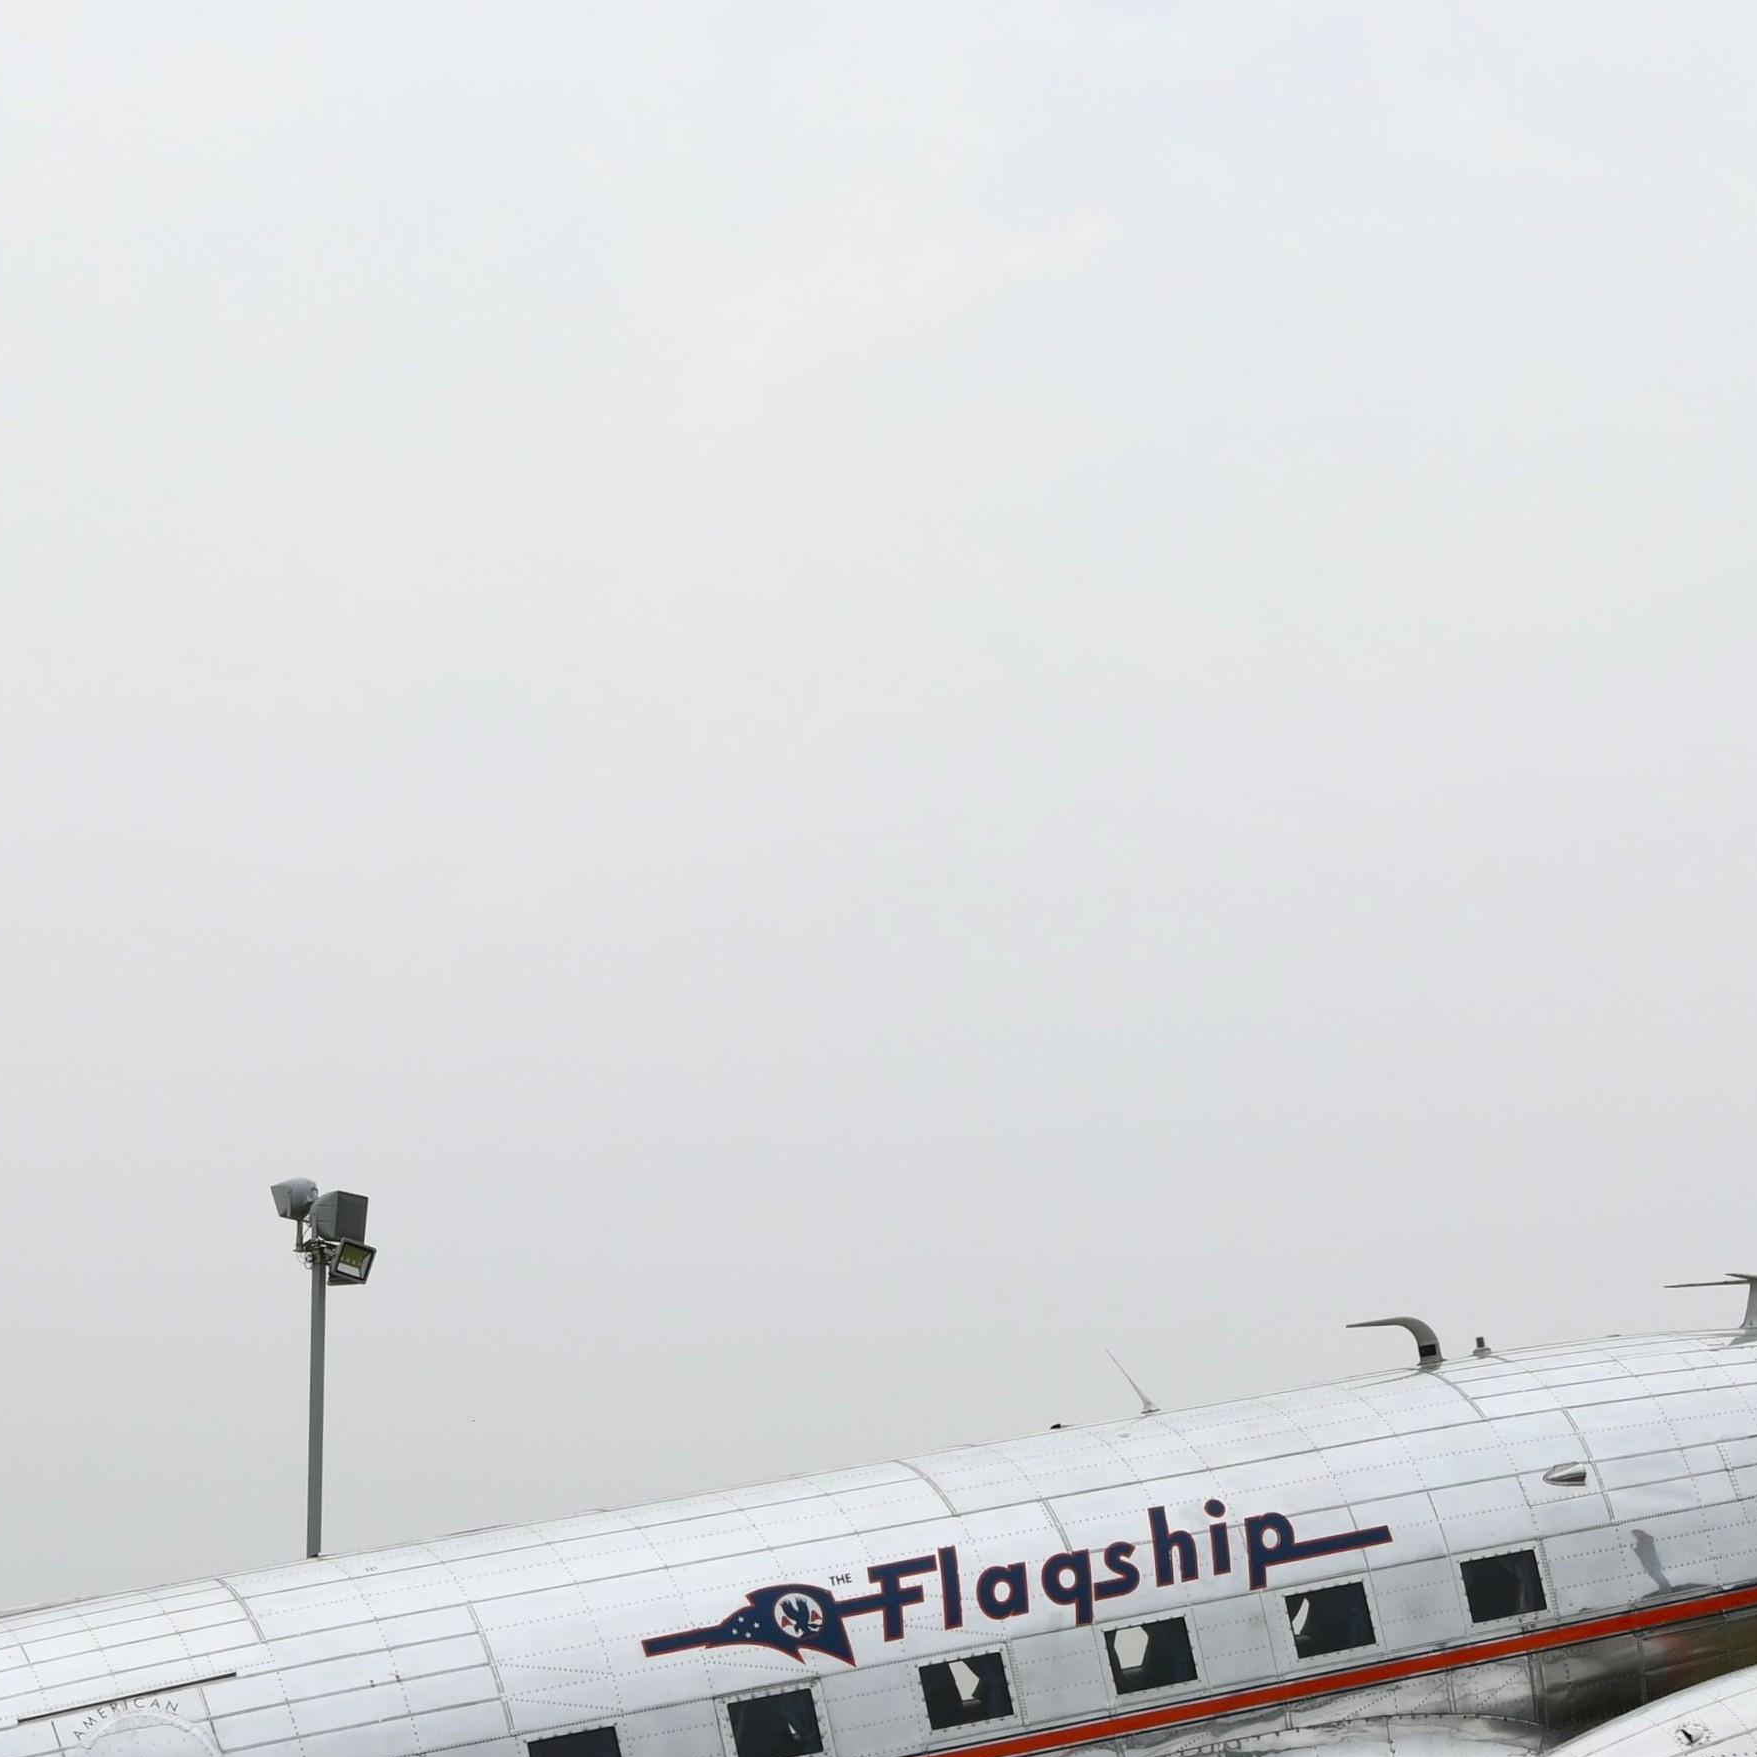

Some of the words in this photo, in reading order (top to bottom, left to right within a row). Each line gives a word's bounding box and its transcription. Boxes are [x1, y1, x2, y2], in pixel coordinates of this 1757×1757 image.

[829, 1573, 853, 1586] THE
[865, 1499, 1392, 1642] Flagship
[72, 1697, 179, 1741] AMERICAN
